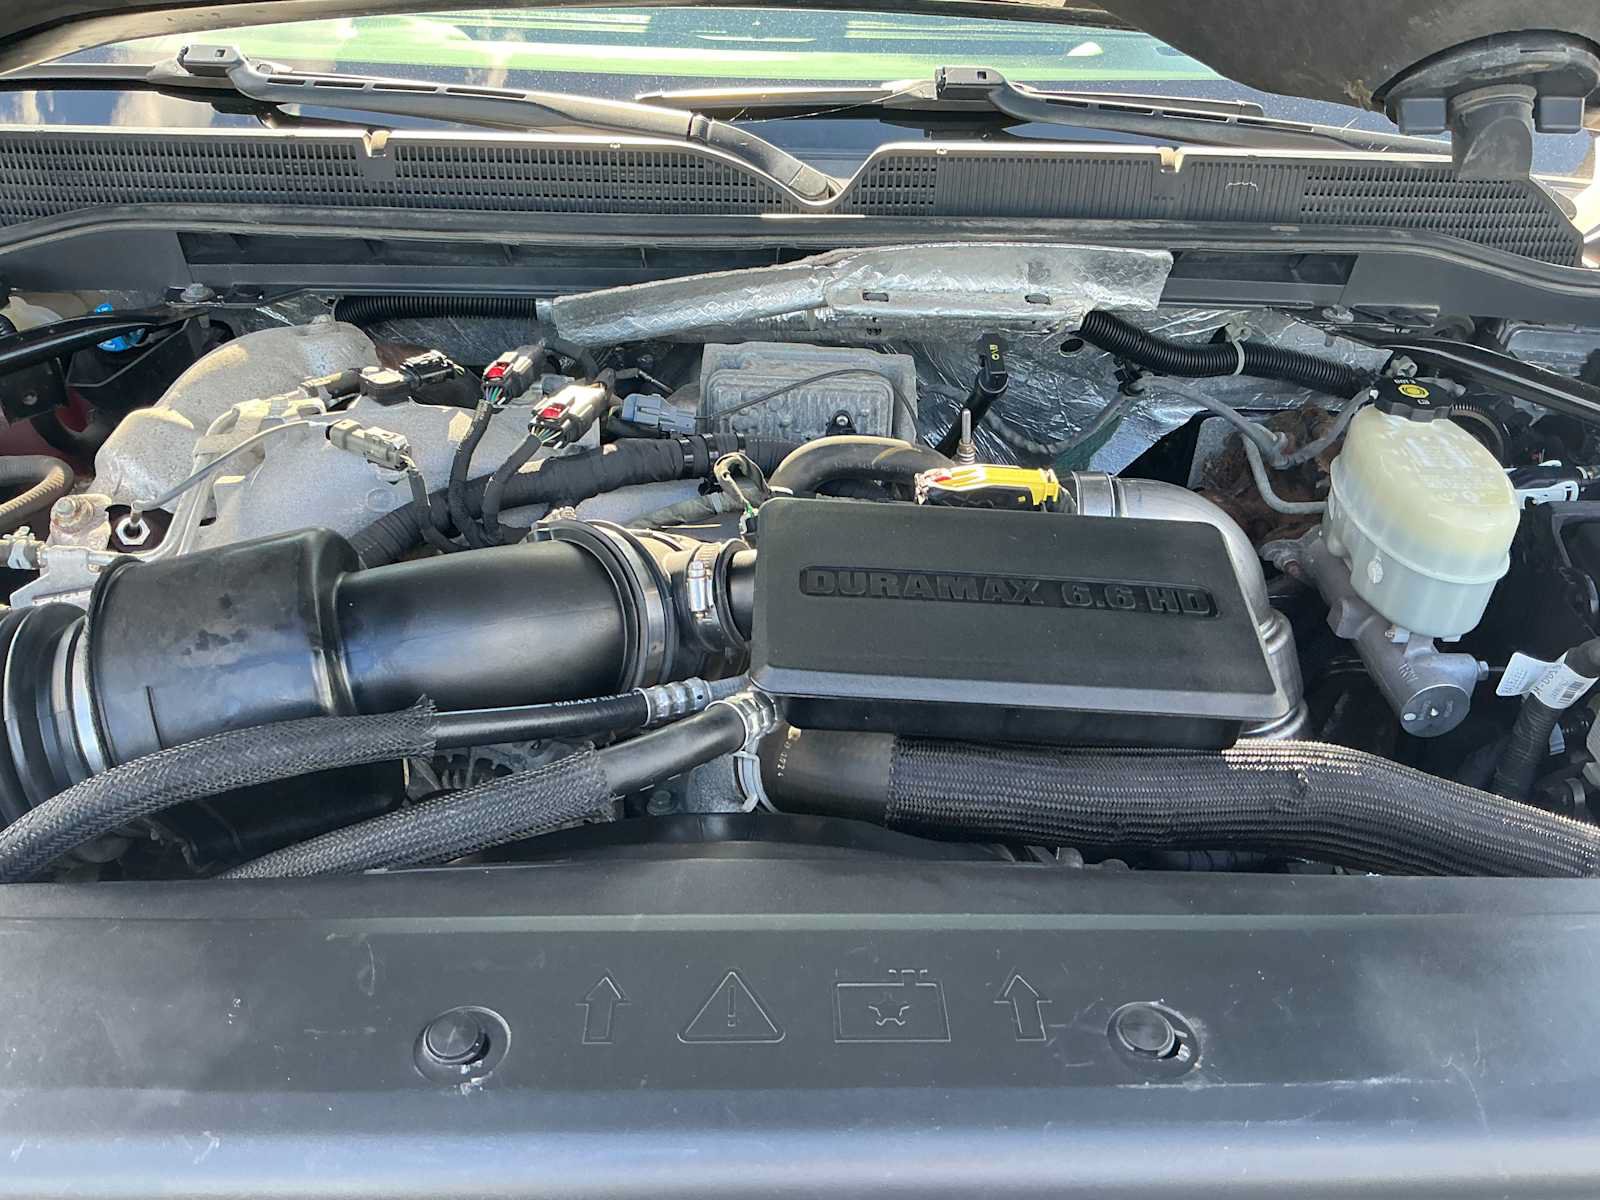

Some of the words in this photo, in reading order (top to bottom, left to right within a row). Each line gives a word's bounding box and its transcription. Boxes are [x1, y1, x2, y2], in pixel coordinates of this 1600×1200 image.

[806, 568, 1044, 604] DURAMAX
[1061, 581, 1137, 610] 6.6
[1145, 585, 1212, 615] HD
[554, 697, 598, 707] GALAXY
